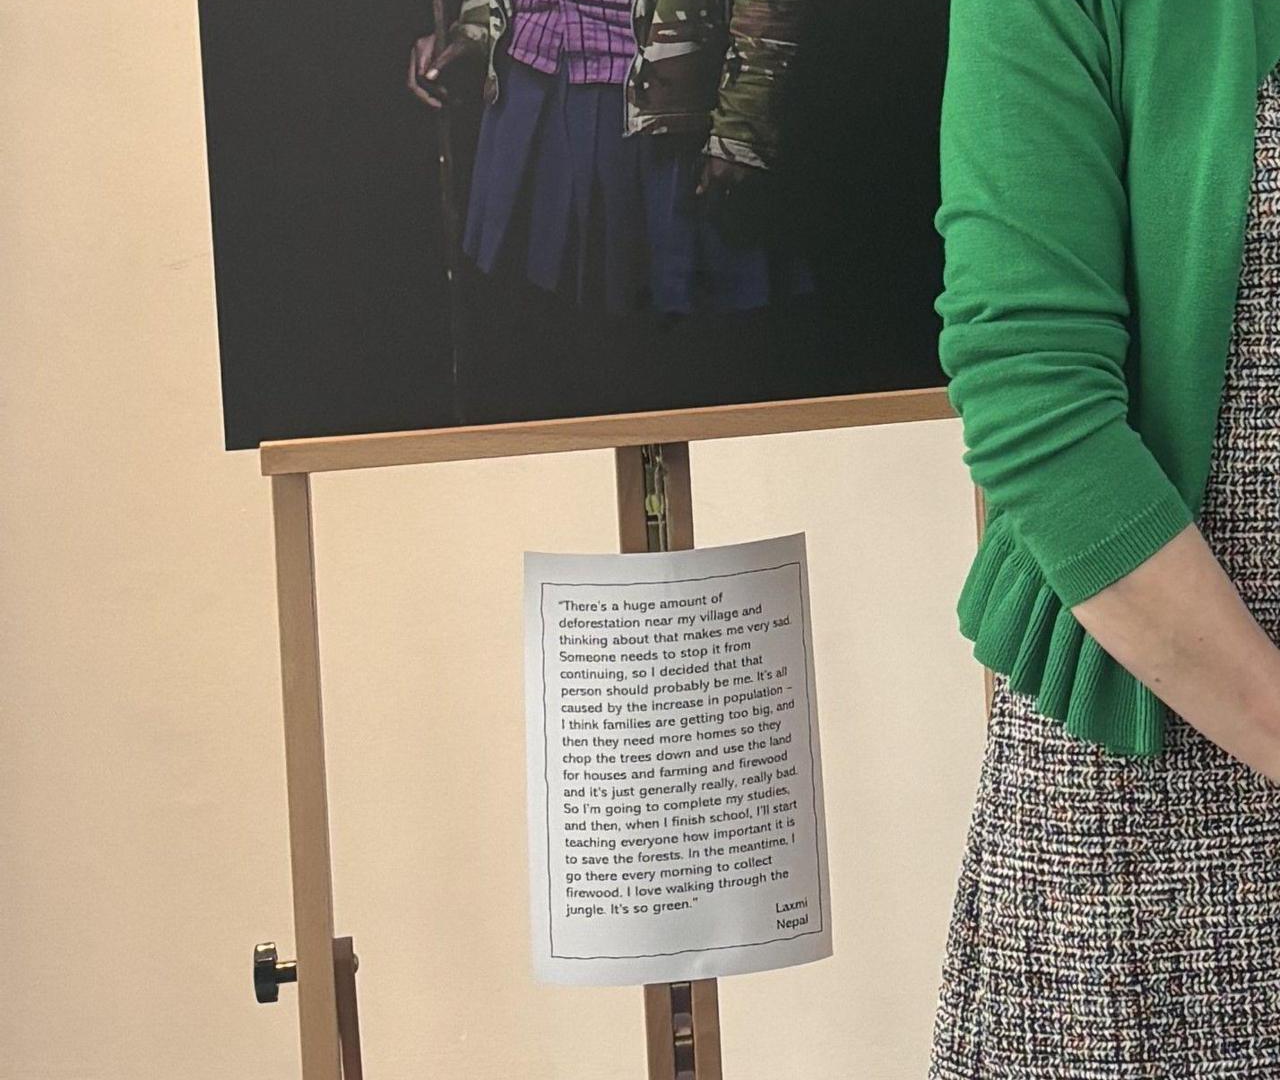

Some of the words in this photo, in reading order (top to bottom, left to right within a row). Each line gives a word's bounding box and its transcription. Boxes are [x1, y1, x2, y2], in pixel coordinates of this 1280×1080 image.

[612, 603, 619, 611] a
[623, 599, 655, 613] huge
[660, 595, 707, 609] amount
[711, 591, 723, 604] of
[559, 616, 640, 629] deforestation
[645, 616, 673, 627] near
[677, 614, 696, 627] my
[700, 609, 738, 622] village
[742, 603, 762, 617] and
[559, 634, 608, 648] thinking
[612, 633, 649, 646] about
[654, 632, 678, 644] that
[683, 627, 722, 641] makes
[726, 625, 744, 636] me
[747, 621, 769, 633] very
[773, 615, 792, 628] sad.
[559, 650, 616, 663] Someone
[620, 649, 658, 662] needs
[662, 649, 676, 661] to
[680, 647, 708, 659] stop
[712, 643, 720, 655] it
[724, 640, 751, 654] from
[560, 667, 627, 681] continuing,
[632, 669, 647, 679] so
[659, 660, 709, 677] decided
[714, 656, 737, 672] that
[741, 655, 762, 668] that
[561, 687, 602, 699] person
[606, 683, 648, 697] should
[654, 678, 710, 697] probably
[714, 677, 729, 689] be
[733, 671, 753, 686] me.
[757, 669, 773, 682] It's
[776, 666, 787, 679] all
[561, 702, 603, 714] caused
[607, 701, 622, 715] by
[627, 701, 647, 713] the
[652, 696, 703, 712] increase
[708, 694, 719, 706] in
[723, 683, 783, 707] population
[569, 718, 599, 731] think
[603, 717, 651, 731] families
[655, 718, 676, 728] are
[680, 711, 724, 728] getting
[729, 706, 749, 720] too
[752, 704, 773, 717] big,
[776, 698, 794, 712] and
[775, 896, 809, 914] Laxmi
[776, 914, 809, 930] Nepal
